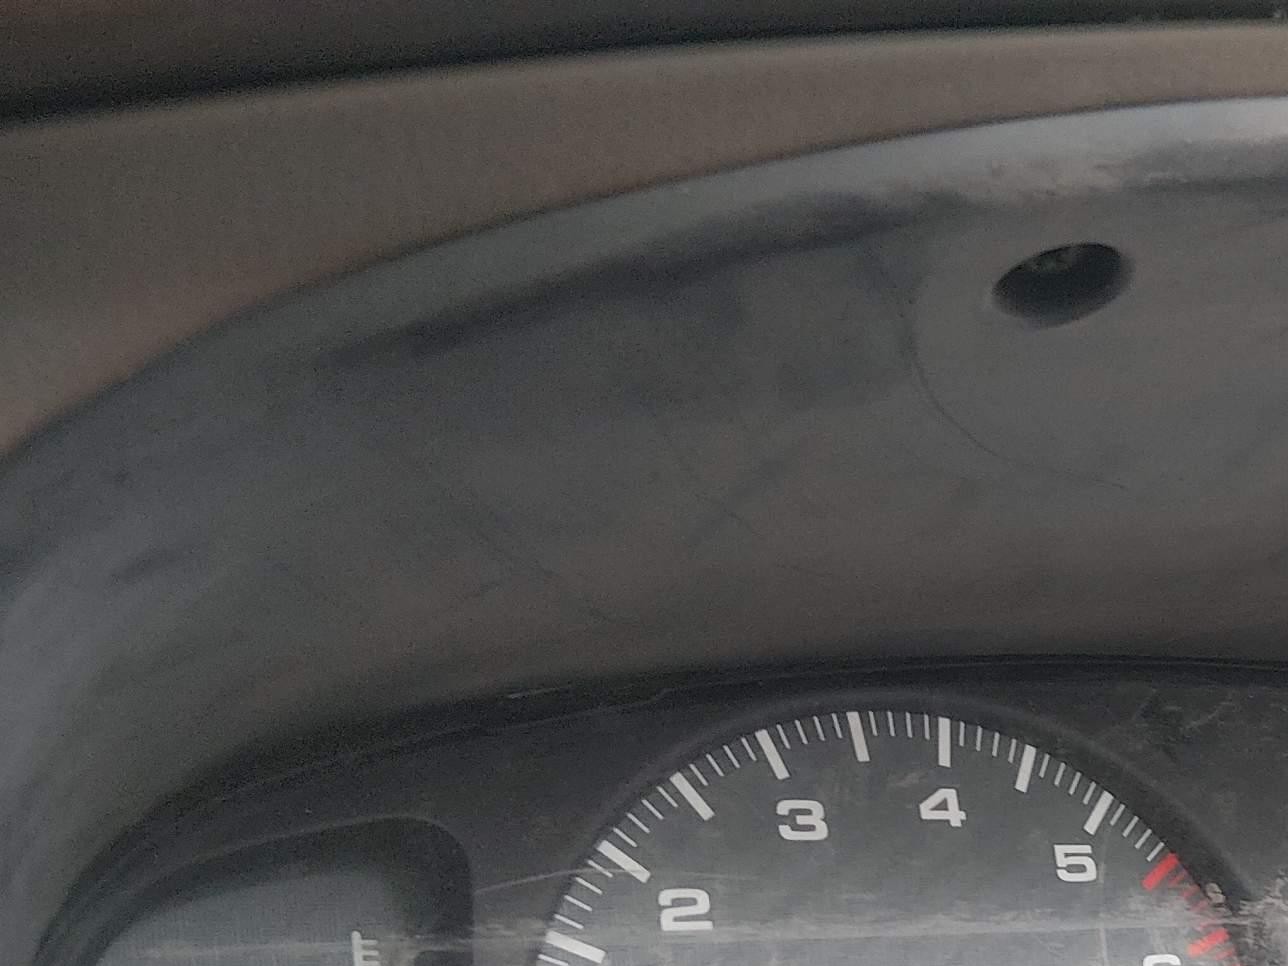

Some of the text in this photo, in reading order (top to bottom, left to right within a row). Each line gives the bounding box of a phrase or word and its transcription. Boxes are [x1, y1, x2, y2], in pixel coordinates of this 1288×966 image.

[776, 799, 830, 842] 3
[920, 789, 967, 827] 4
[1054, 845, 1099, 884] 5
[658, 888, 713, 931] 2
